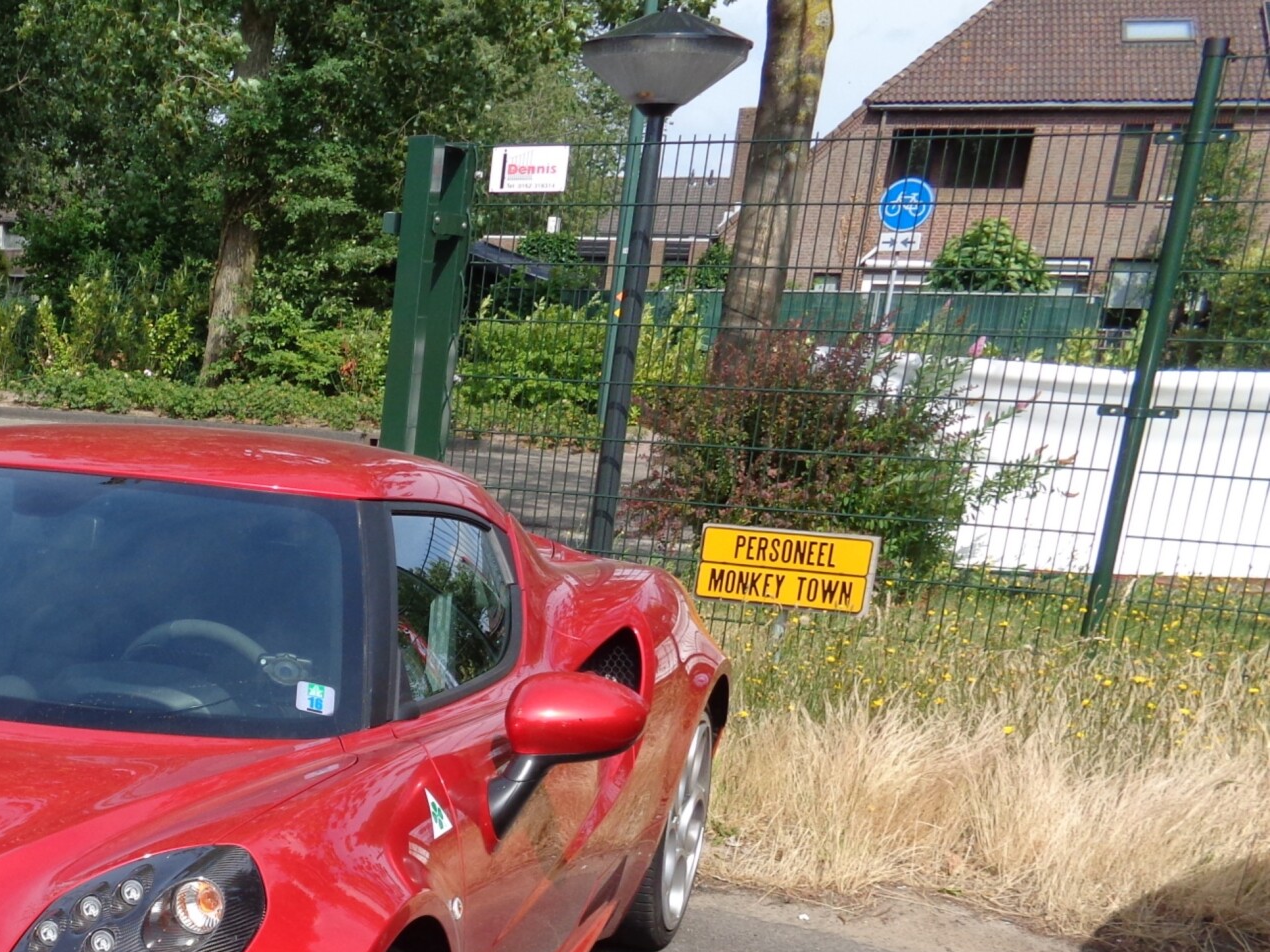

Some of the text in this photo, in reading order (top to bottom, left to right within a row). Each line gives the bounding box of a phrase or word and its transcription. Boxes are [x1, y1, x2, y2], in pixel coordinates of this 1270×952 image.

[507, 163, 557, 176] Dennis
[734, 535, 836, 568] PERSONEEL
[708, 568, 853, 605] MONKEY TOWN
